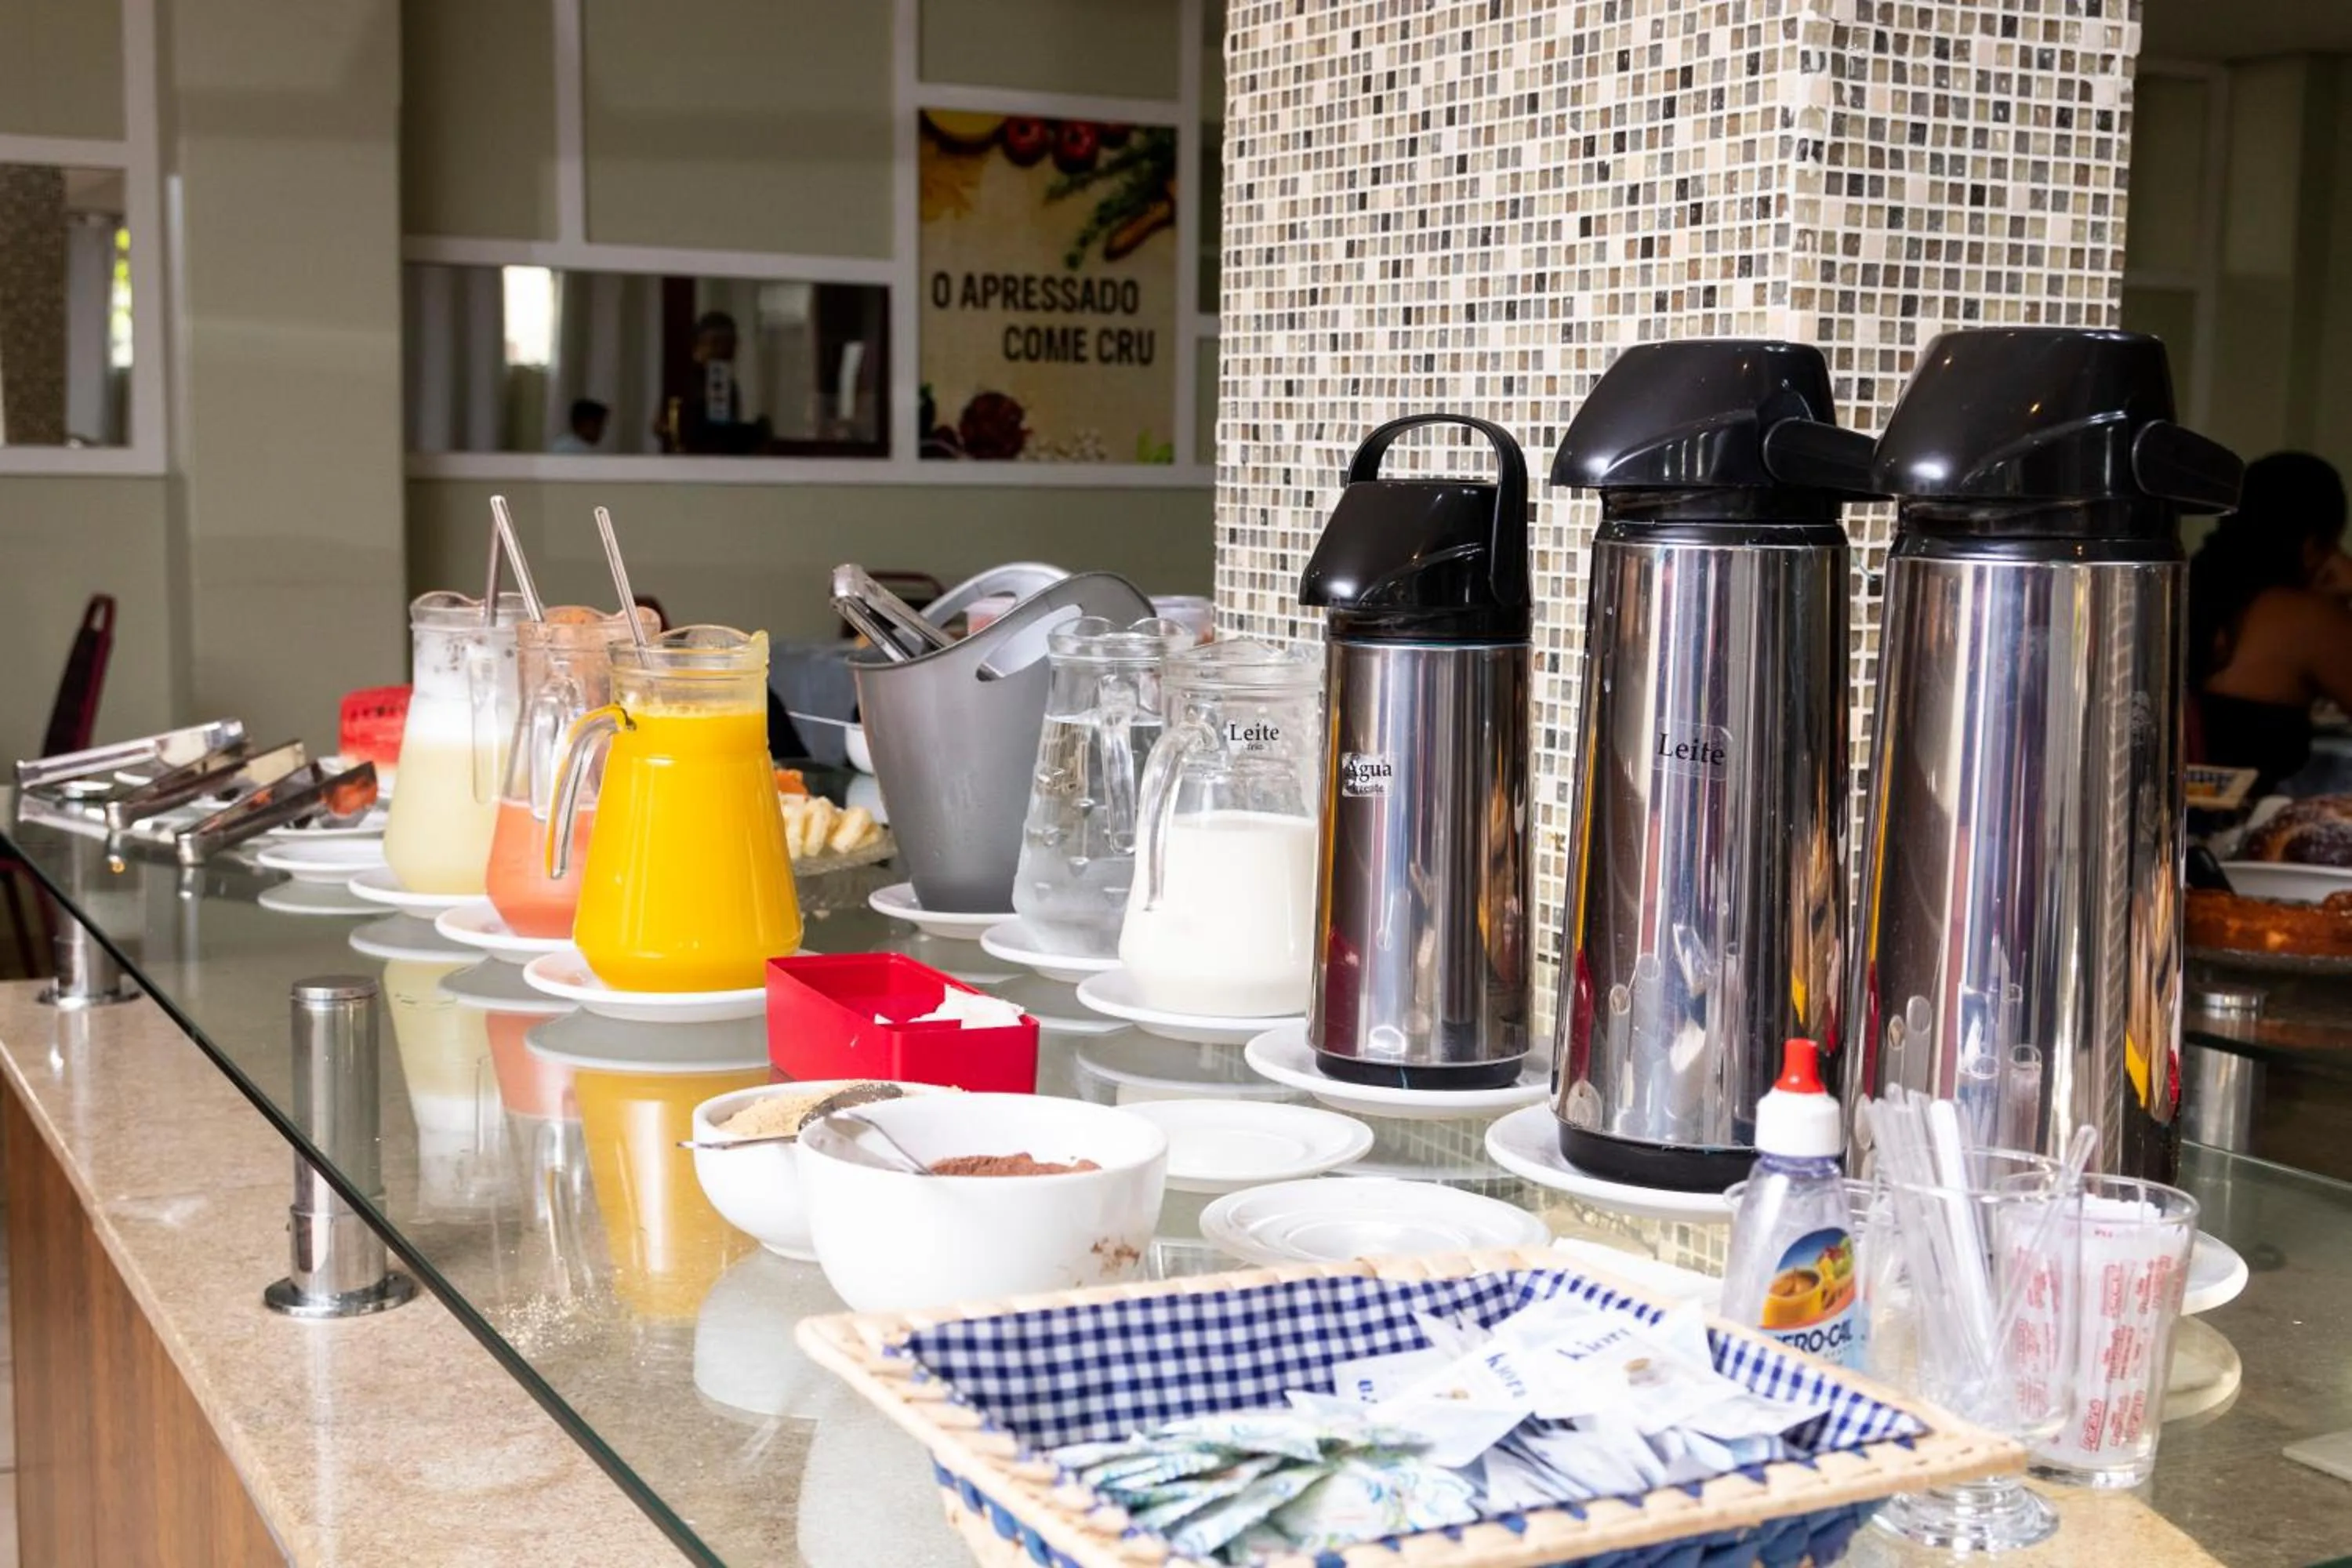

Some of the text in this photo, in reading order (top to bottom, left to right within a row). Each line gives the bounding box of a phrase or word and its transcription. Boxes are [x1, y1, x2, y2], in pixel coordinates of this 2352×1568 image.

[931, 271, 1139, 314] O APRESSADO
[1003, 325, 1156, 366] COME CRU
[1230, 723, 1279, 741] Leite
[1657, 732, 1725, 765] Leite
